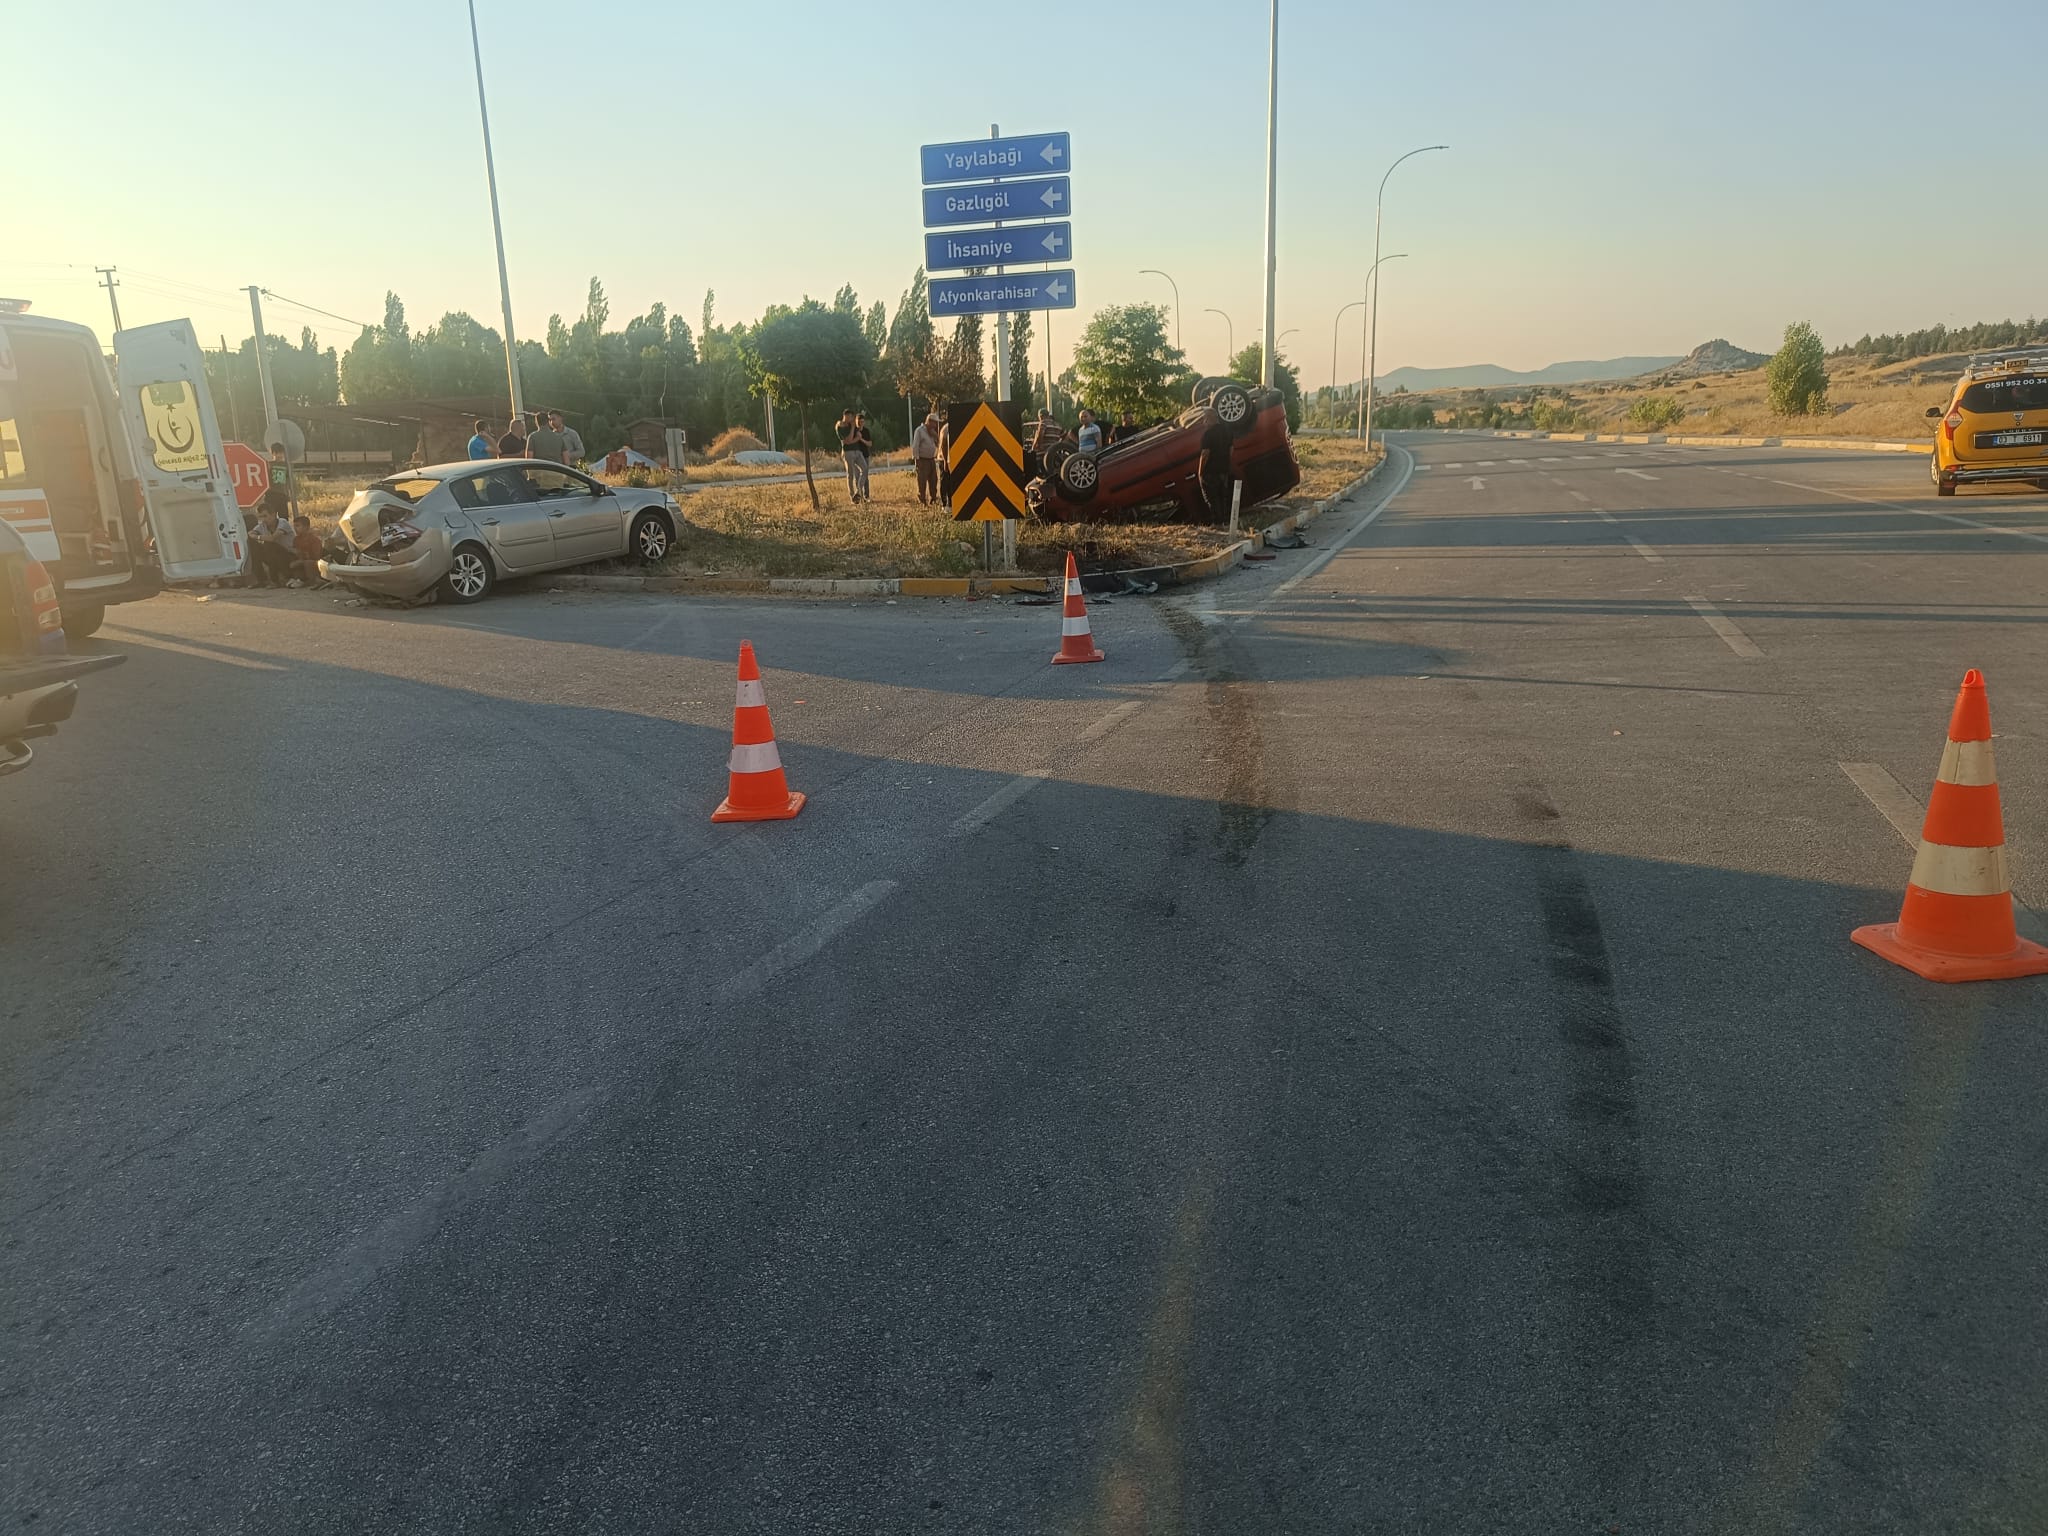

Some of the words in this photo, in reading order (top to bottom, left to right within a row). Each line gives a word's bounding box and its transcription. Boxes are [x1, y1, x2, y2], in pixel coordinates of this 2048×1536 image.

[945, 148, 1022, 171] Yaylabağı
[946, 192, 1010, 212] Gazlıgöl
[947, 240, 1013, 258] İhsaniye
[938, 286, 1038, 305] Afyonkarahisar
[1985, 381, 2004, 389] 0551
[226, 464, 263, 487] UR
